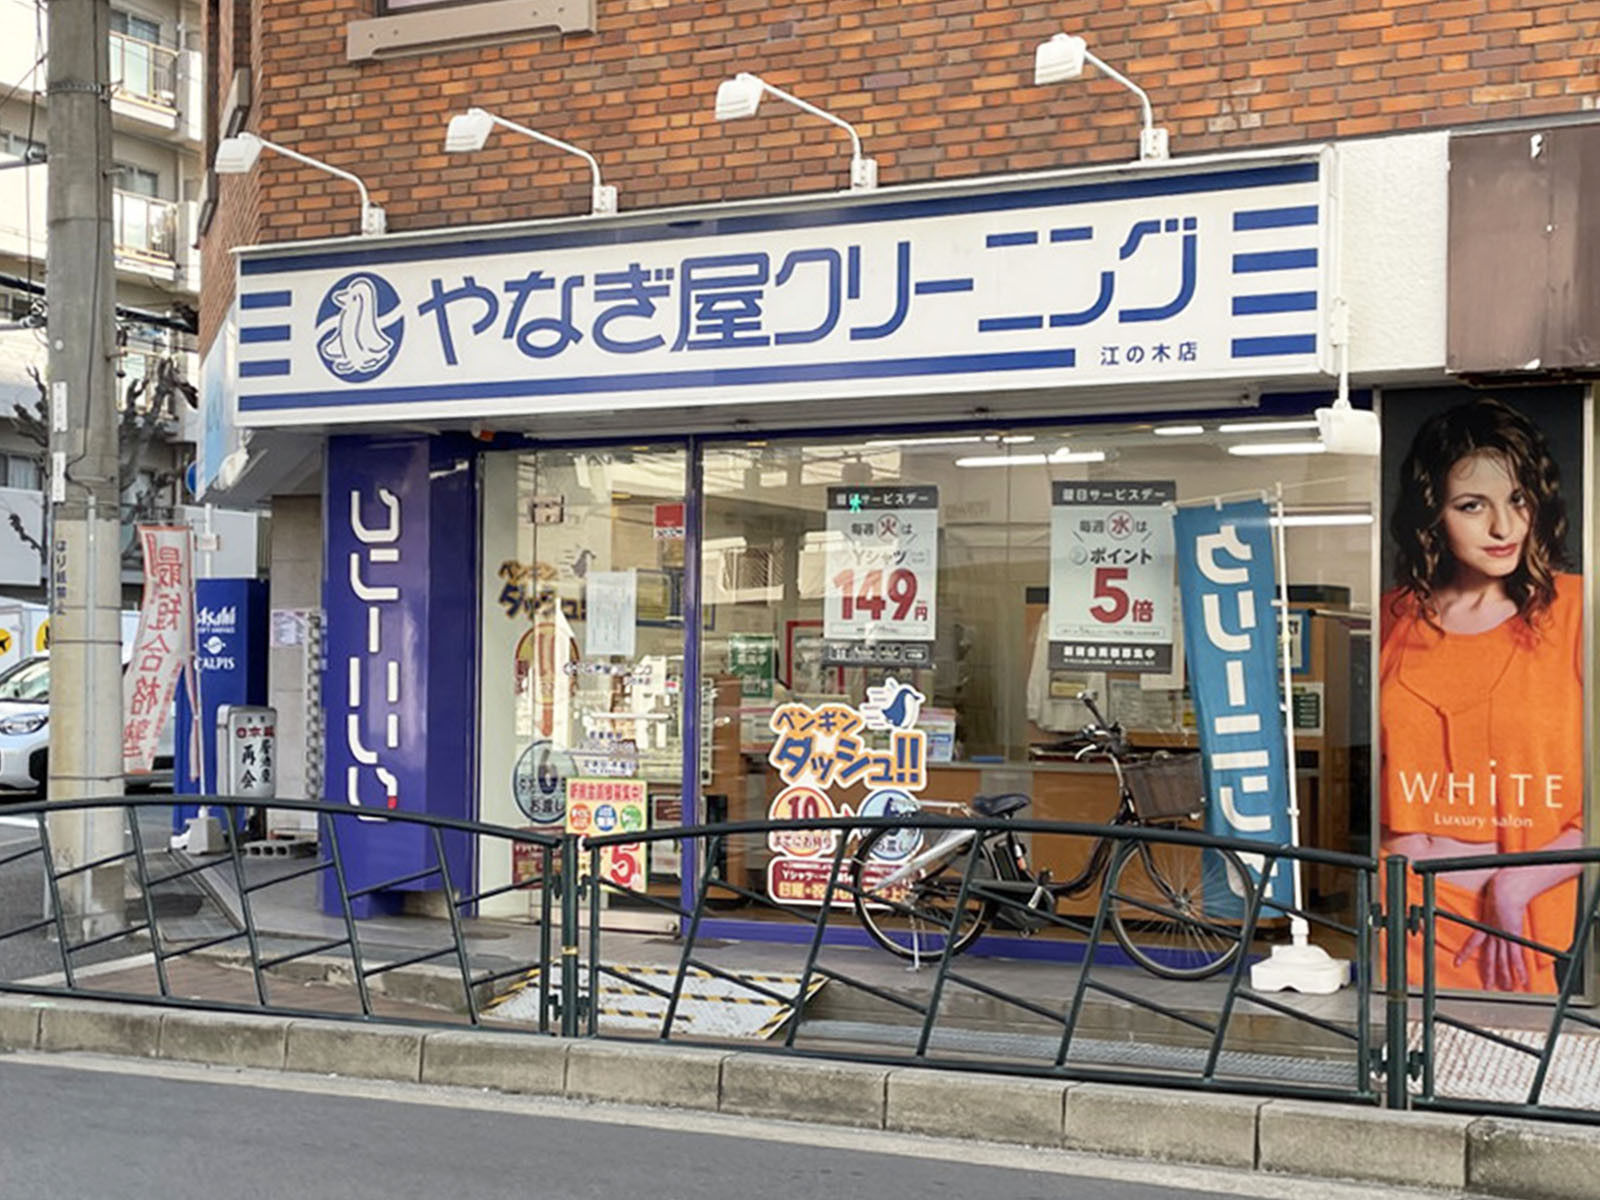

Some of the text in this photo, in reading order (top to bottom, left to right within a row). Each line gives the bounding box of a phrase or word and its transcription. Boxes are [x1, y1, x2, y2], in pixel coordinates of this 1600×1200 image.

[418, 216, 1198, 366] やなぎ屋クリーニング
[1101, 341, 1198, 366] 江の木店
[852, 549, 907, 566] Yシャツ
[1089, 547, 1153, 566] ポイント
[56, 540, 67, 616] はり紙禁止
[194, 656, 236, 671] CALPIS
[776, 710, 858, 733] ペンギン
[240, 743, 257, 790] 再会
[1434, 812, 1533, 828] Luxury salon
